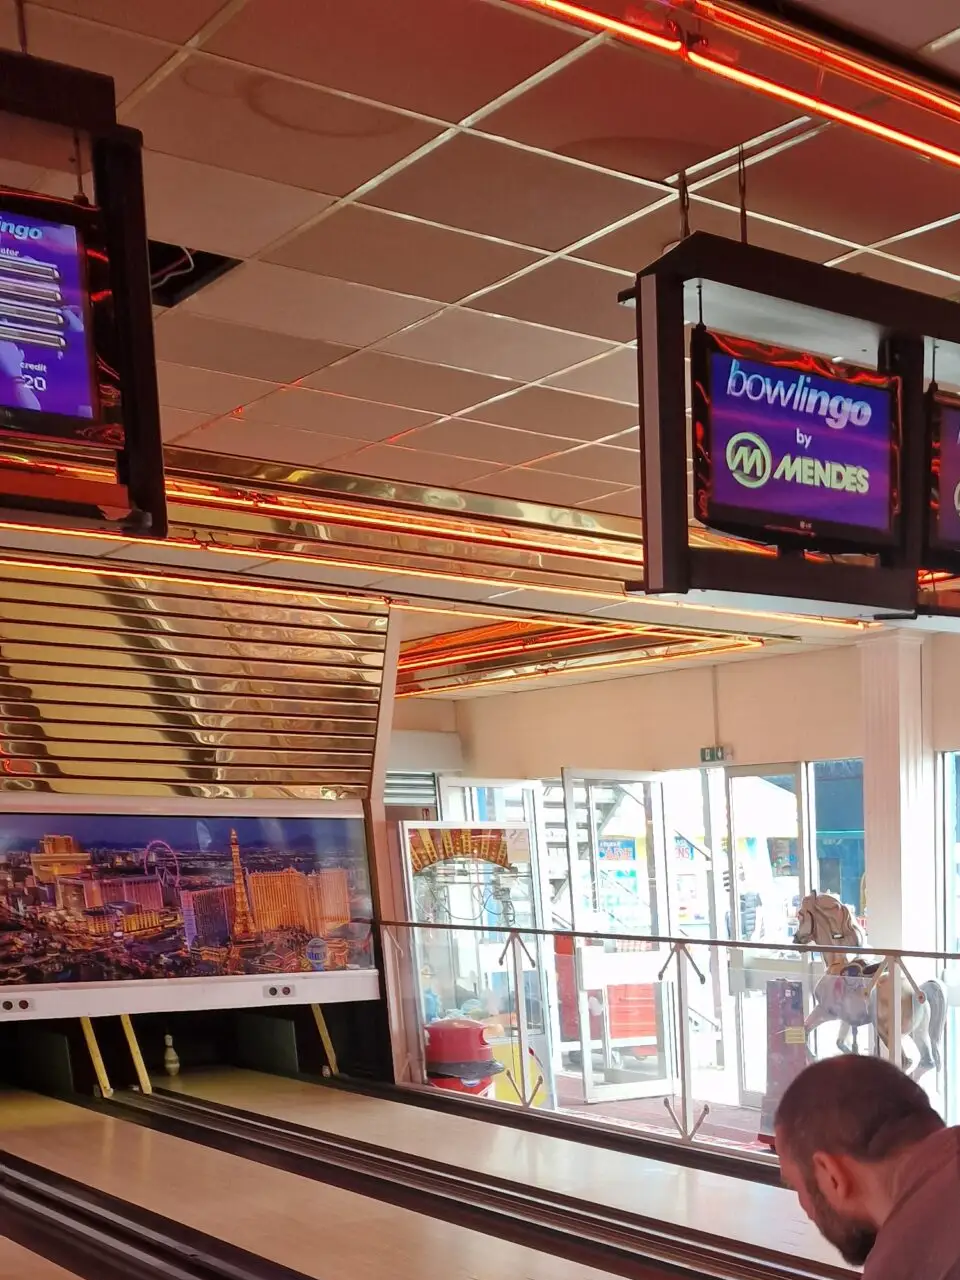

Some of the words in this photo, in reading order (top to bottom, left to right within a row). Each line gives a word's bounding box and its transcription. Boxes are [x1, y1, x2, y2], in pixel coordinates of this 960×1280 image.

[20, 361, 47, 373] credit
[22, 374, 47, 391] 20
[727, 359, 872, 429] bowlingo
[796, 428, 812, 449] by
[773, 453, 870, 494] MENDES
